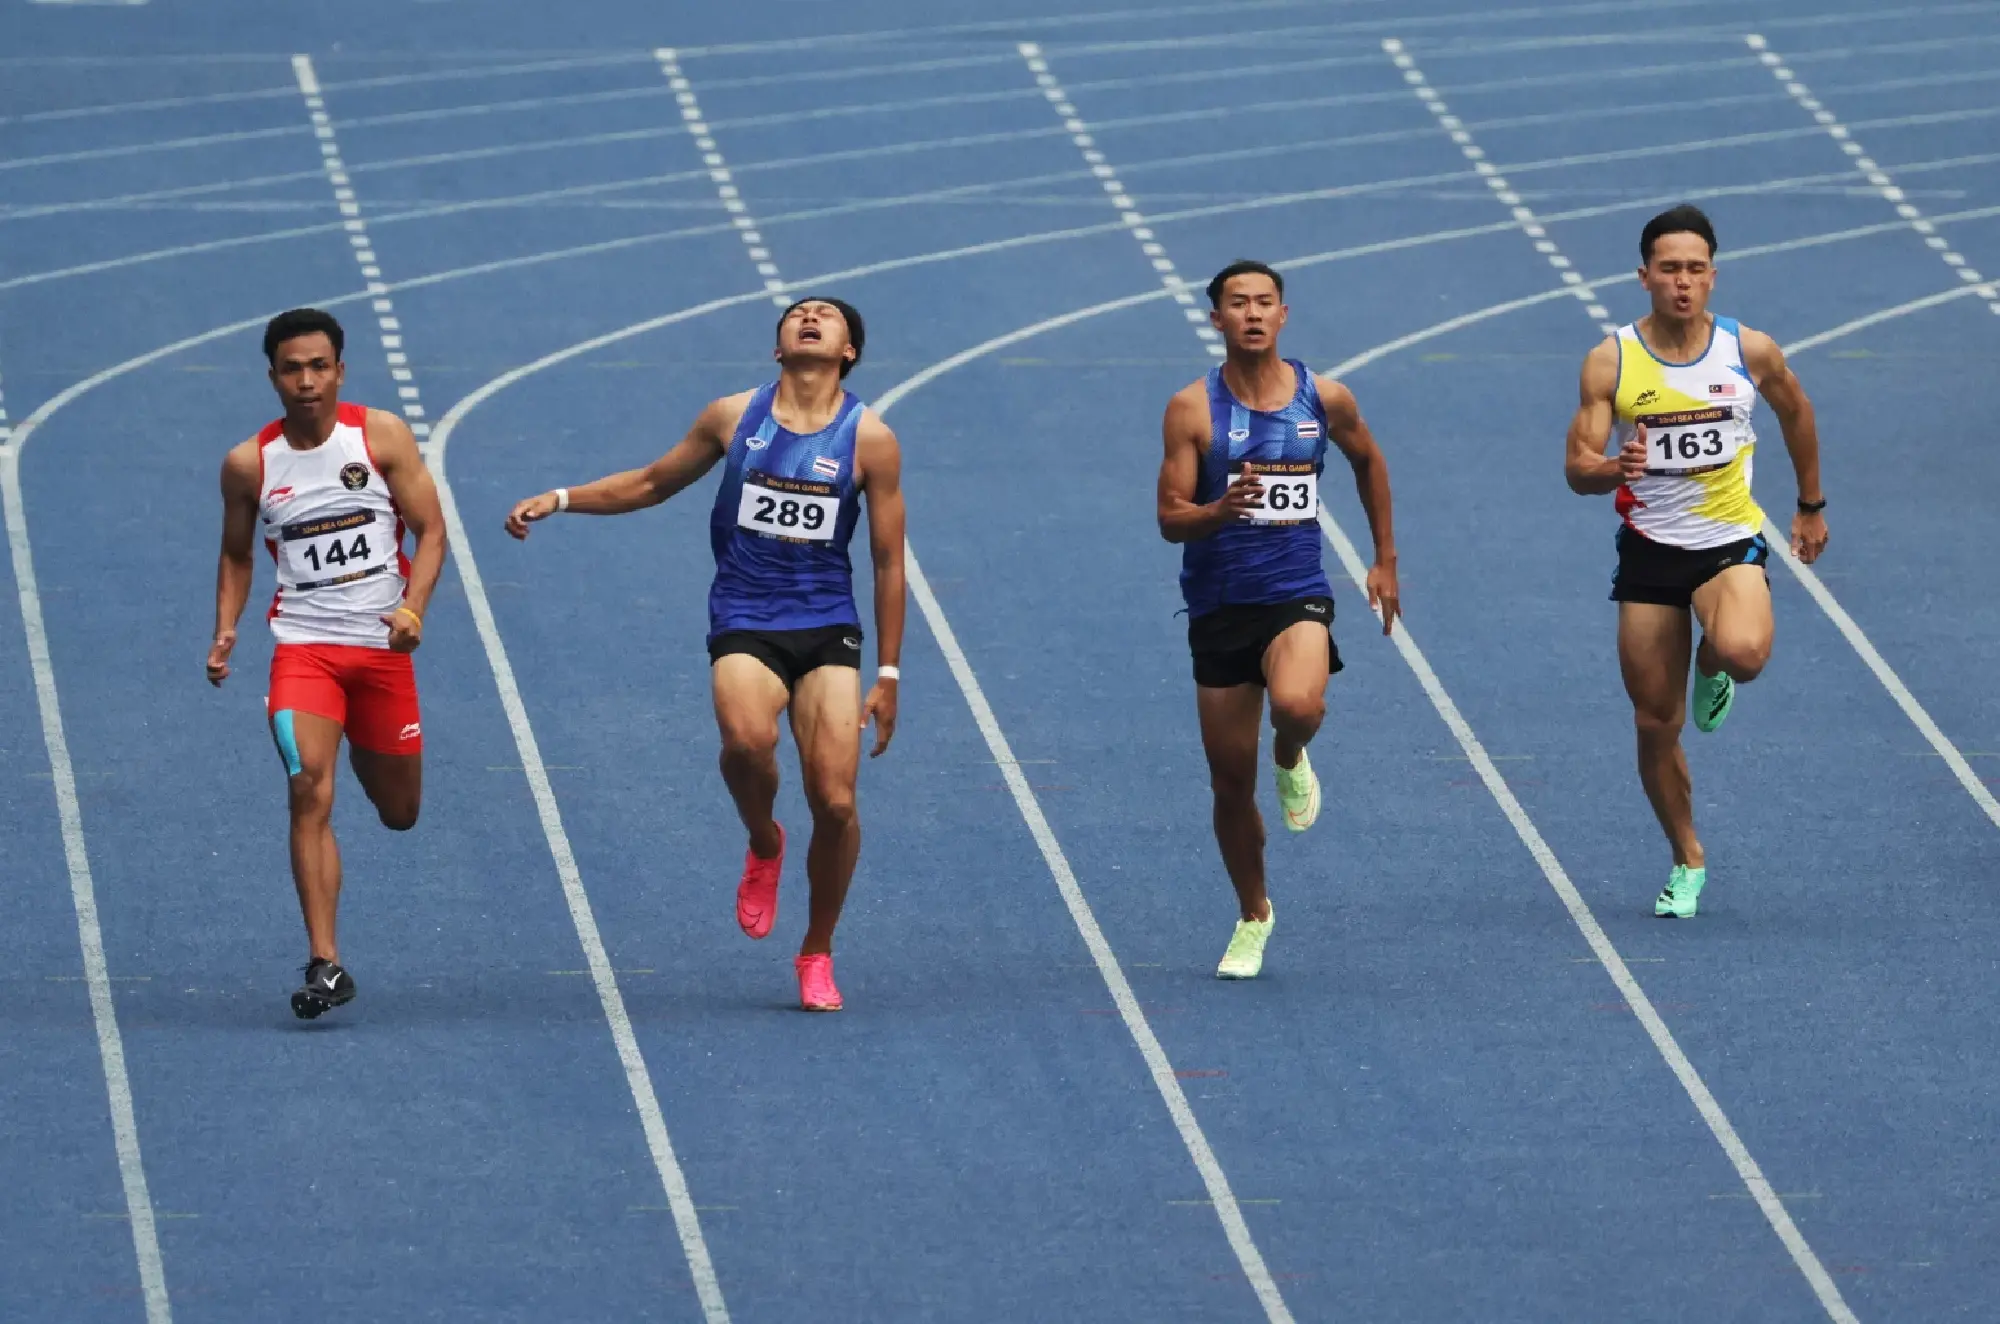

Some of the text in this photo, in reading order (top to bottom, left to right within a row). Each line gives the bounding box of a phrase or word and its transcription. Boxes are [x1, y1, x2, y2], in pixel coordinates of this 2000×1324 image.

[1677, 414, 1692, 422] SEA
[1694, 410, 1722, 420] GAMES
[1655, 429, 1723, 460] 163
[1271, 464, 1287, 472] SEA
[1289, 464, 1312, 472] GAMES
[784, 483, 800, 491] SEA
[802, 484, 831, 494] GAMES
[753, 496, 825, 530] 289
[321, 521, 336, 530] SEA
[337, 514, 366, 527] GAMES
[303, 533, 371, 571] 144
